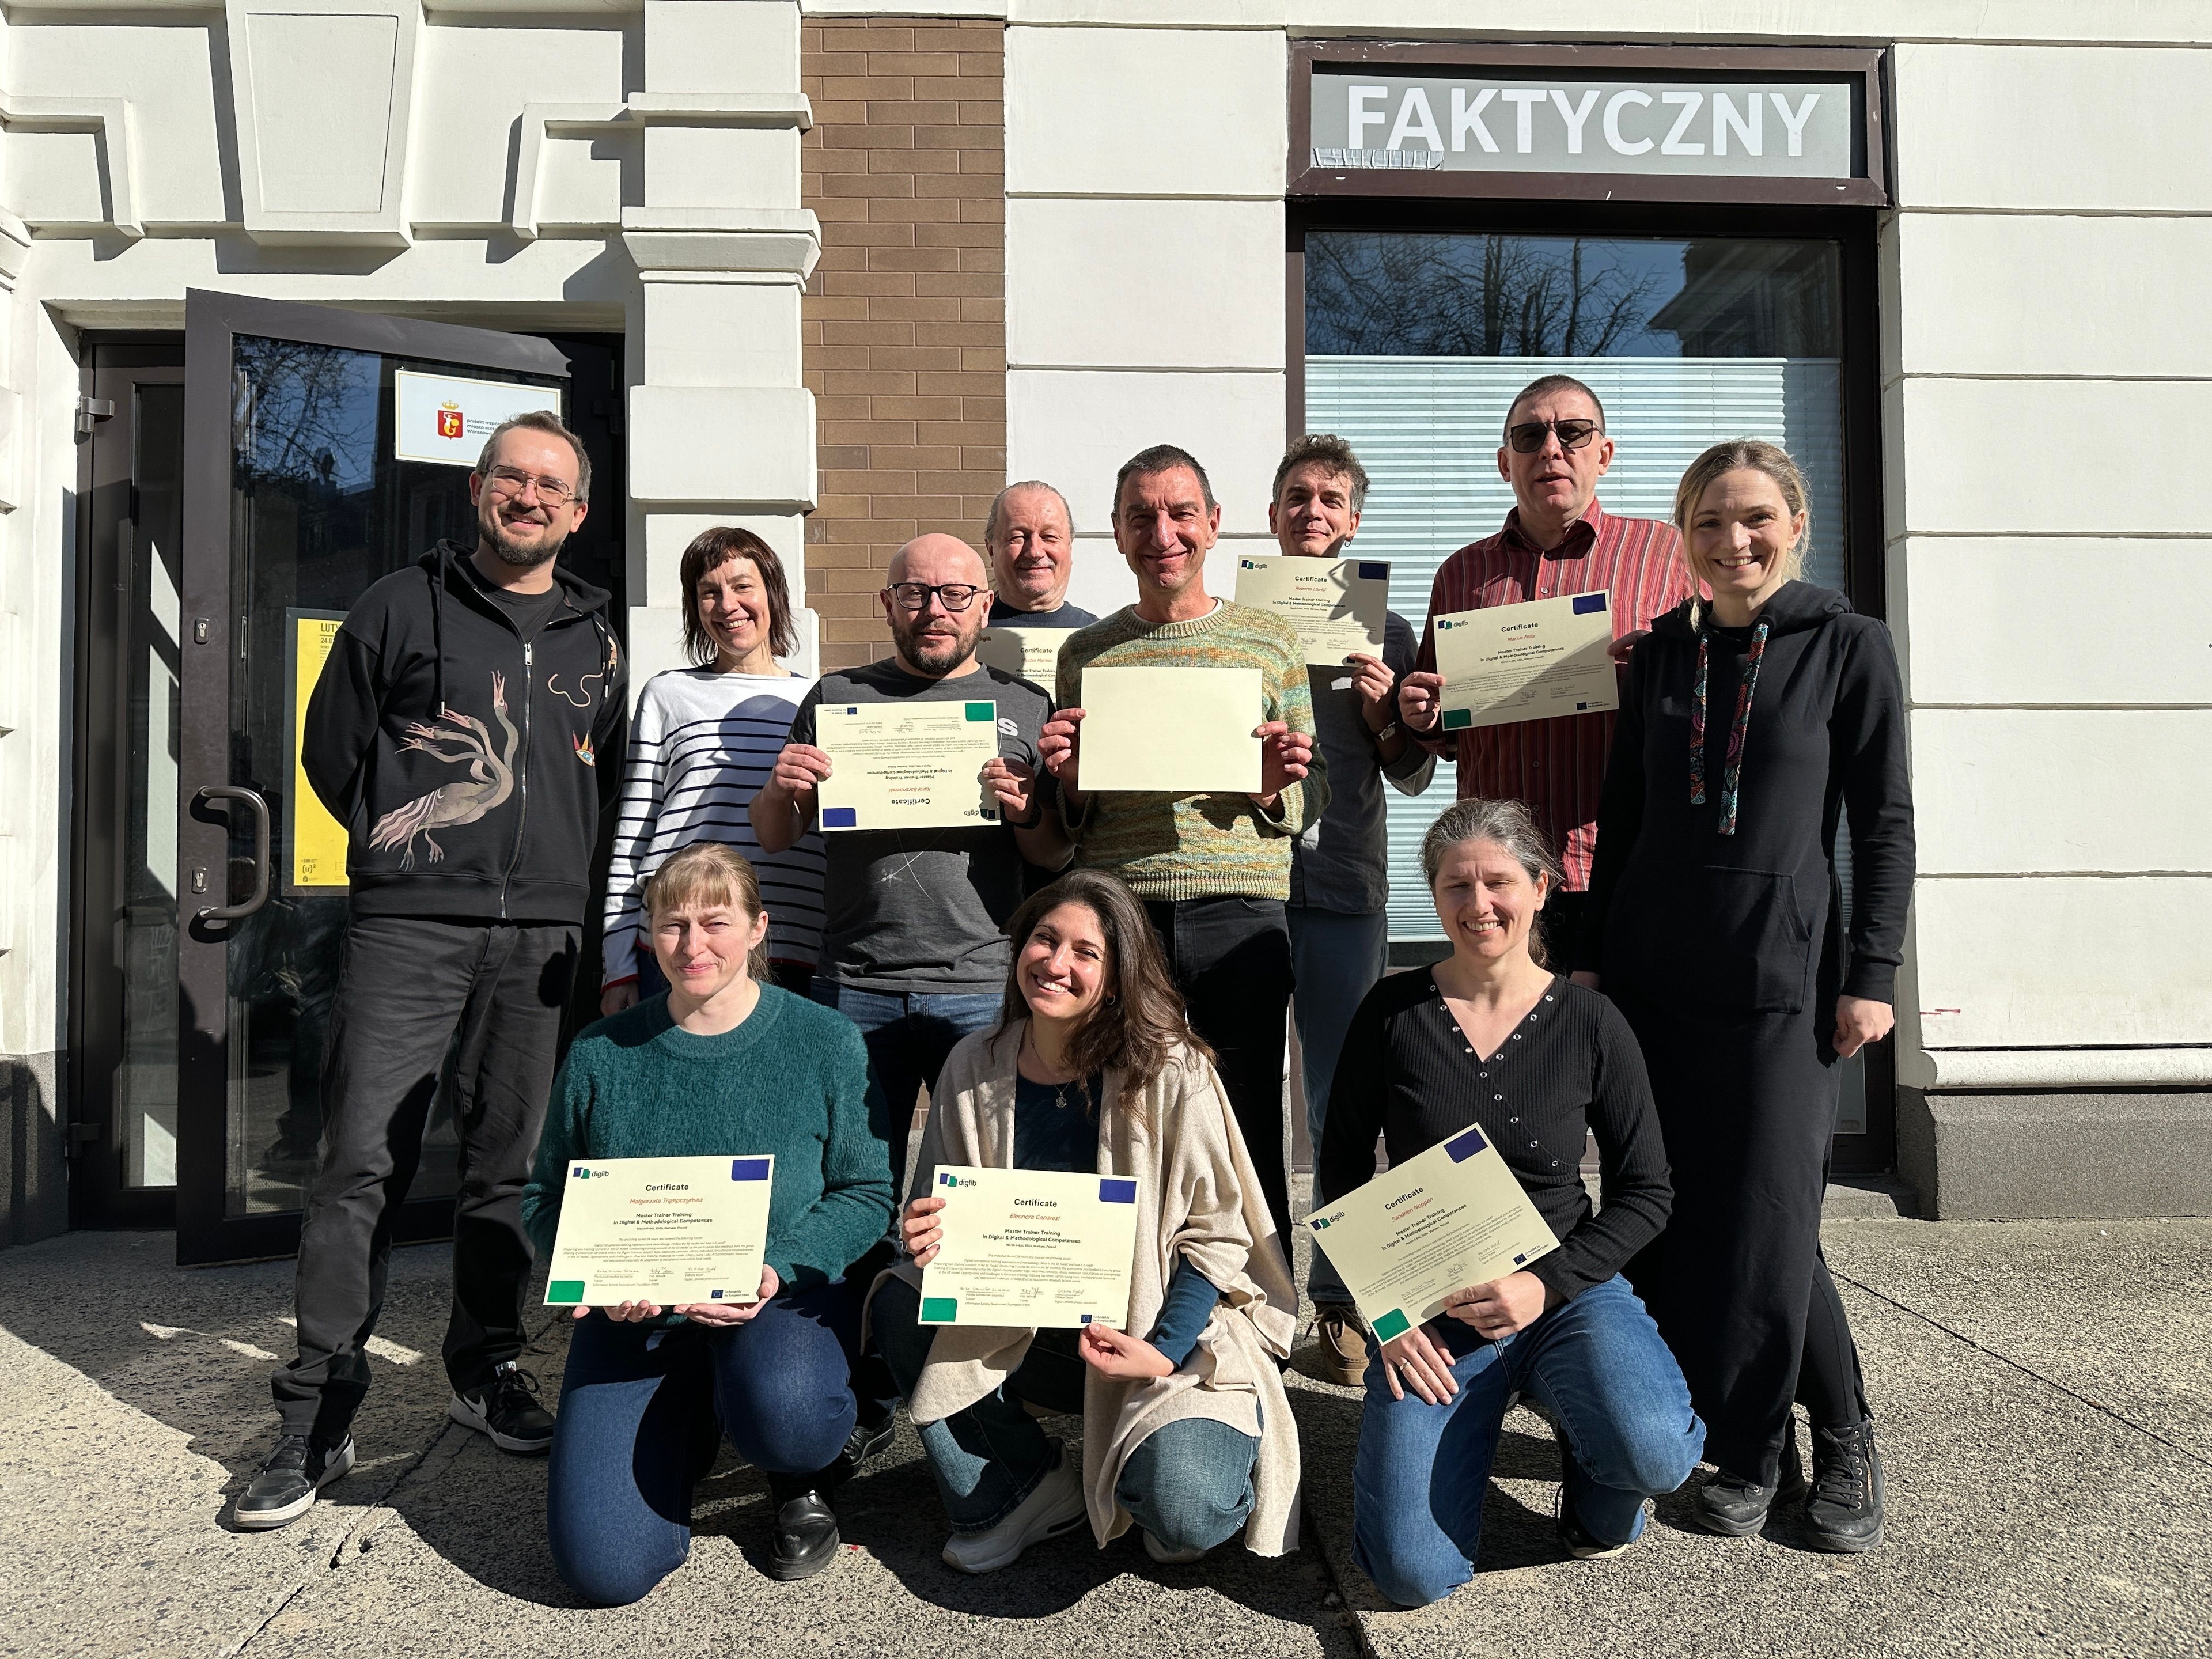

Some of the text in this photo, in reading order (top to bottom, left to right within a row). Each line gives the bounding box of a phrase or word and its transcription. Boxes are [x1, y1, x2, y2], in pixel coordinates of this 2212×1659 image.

[1347, 84, 1822, 157] FAKTYCZNY
[1501, 623, 1539, 632] Certificate
[592, 1171, 609, 1179] diglib
[959, 1179, 976, 1188] diglib
[1014, 1199, 1057, 1207] Certificate
[1385, 1187, 1423, 1210] Certificate
[1330, 1211, 1345, 1222] diglib
[1392, 1198, 1433, 1222] Sandrien Noppen
[1386, 1238, 1400, 1248] Digital
[1404, 1219, 1437, 1238] Methodological
[1437, 1204, 1467, 1221] Competences
[1396, 1209, 1445, 1236] Master Trainer Training
